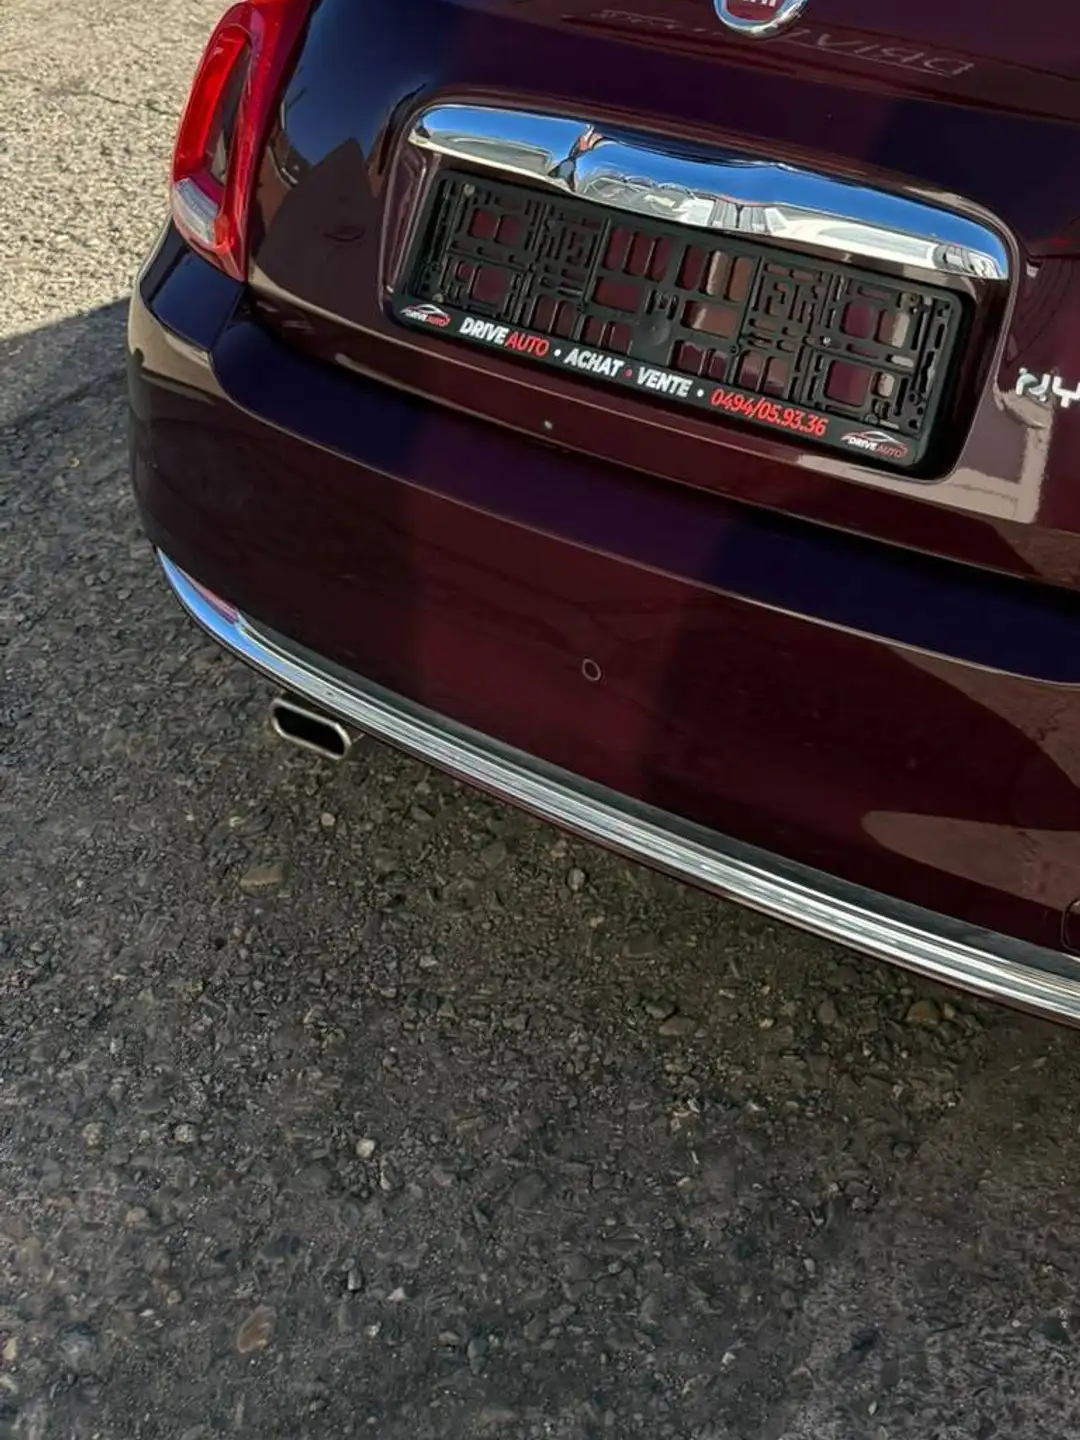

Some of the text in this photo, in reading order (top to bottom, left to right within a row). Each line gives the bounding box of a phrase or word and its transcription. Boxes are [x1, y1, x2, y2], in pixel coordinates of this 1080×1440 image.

[564, 348, 625, 378] ACHAT
[637, 366, 694, 398] VENTE
[710, 388, 829, 437] 0494/05.93.36
